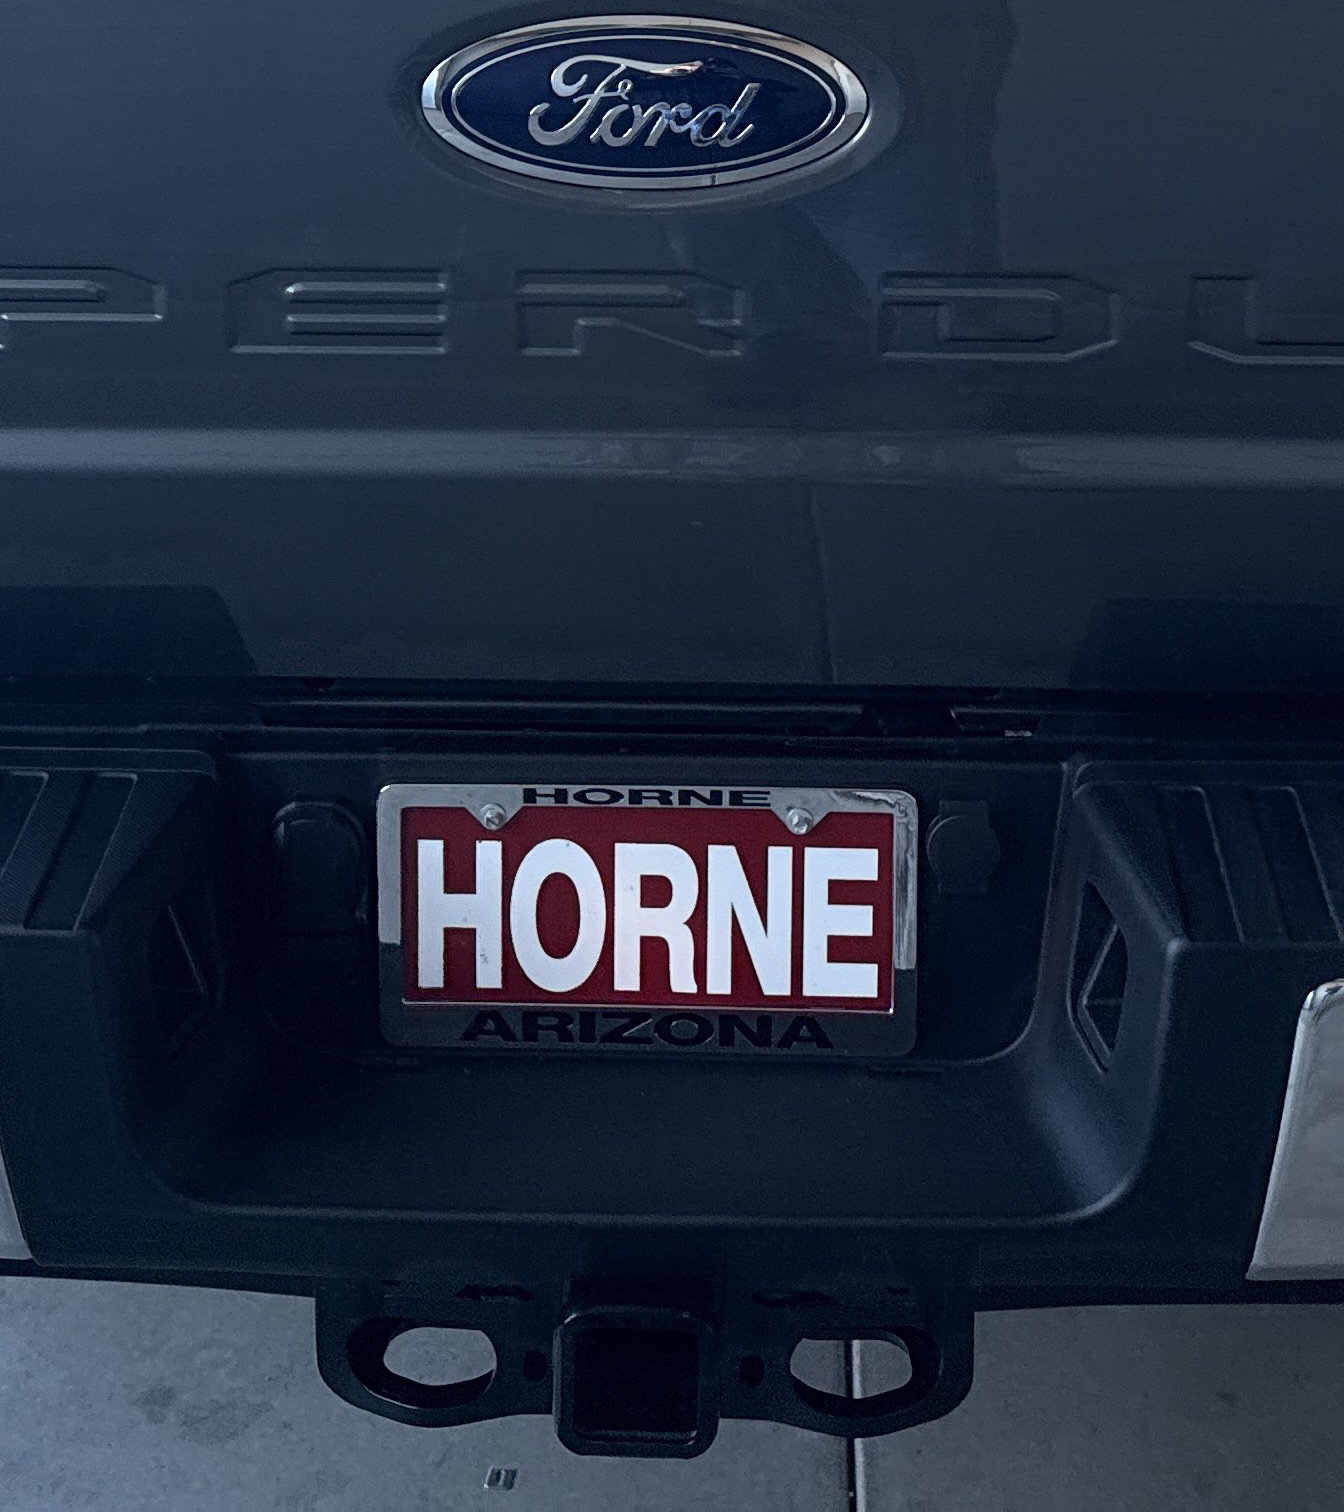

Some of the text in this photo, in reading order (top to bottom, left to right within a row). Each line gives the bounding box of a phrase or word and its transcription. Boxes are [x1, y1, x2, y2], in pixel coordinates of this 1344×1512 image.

[527, 53, 762, 150] Ford
[521, 787, 772, 808] HORNE
[416, 837, 880, 999] HORNE
[460, 1009, 836, 1051] ARIZONA
